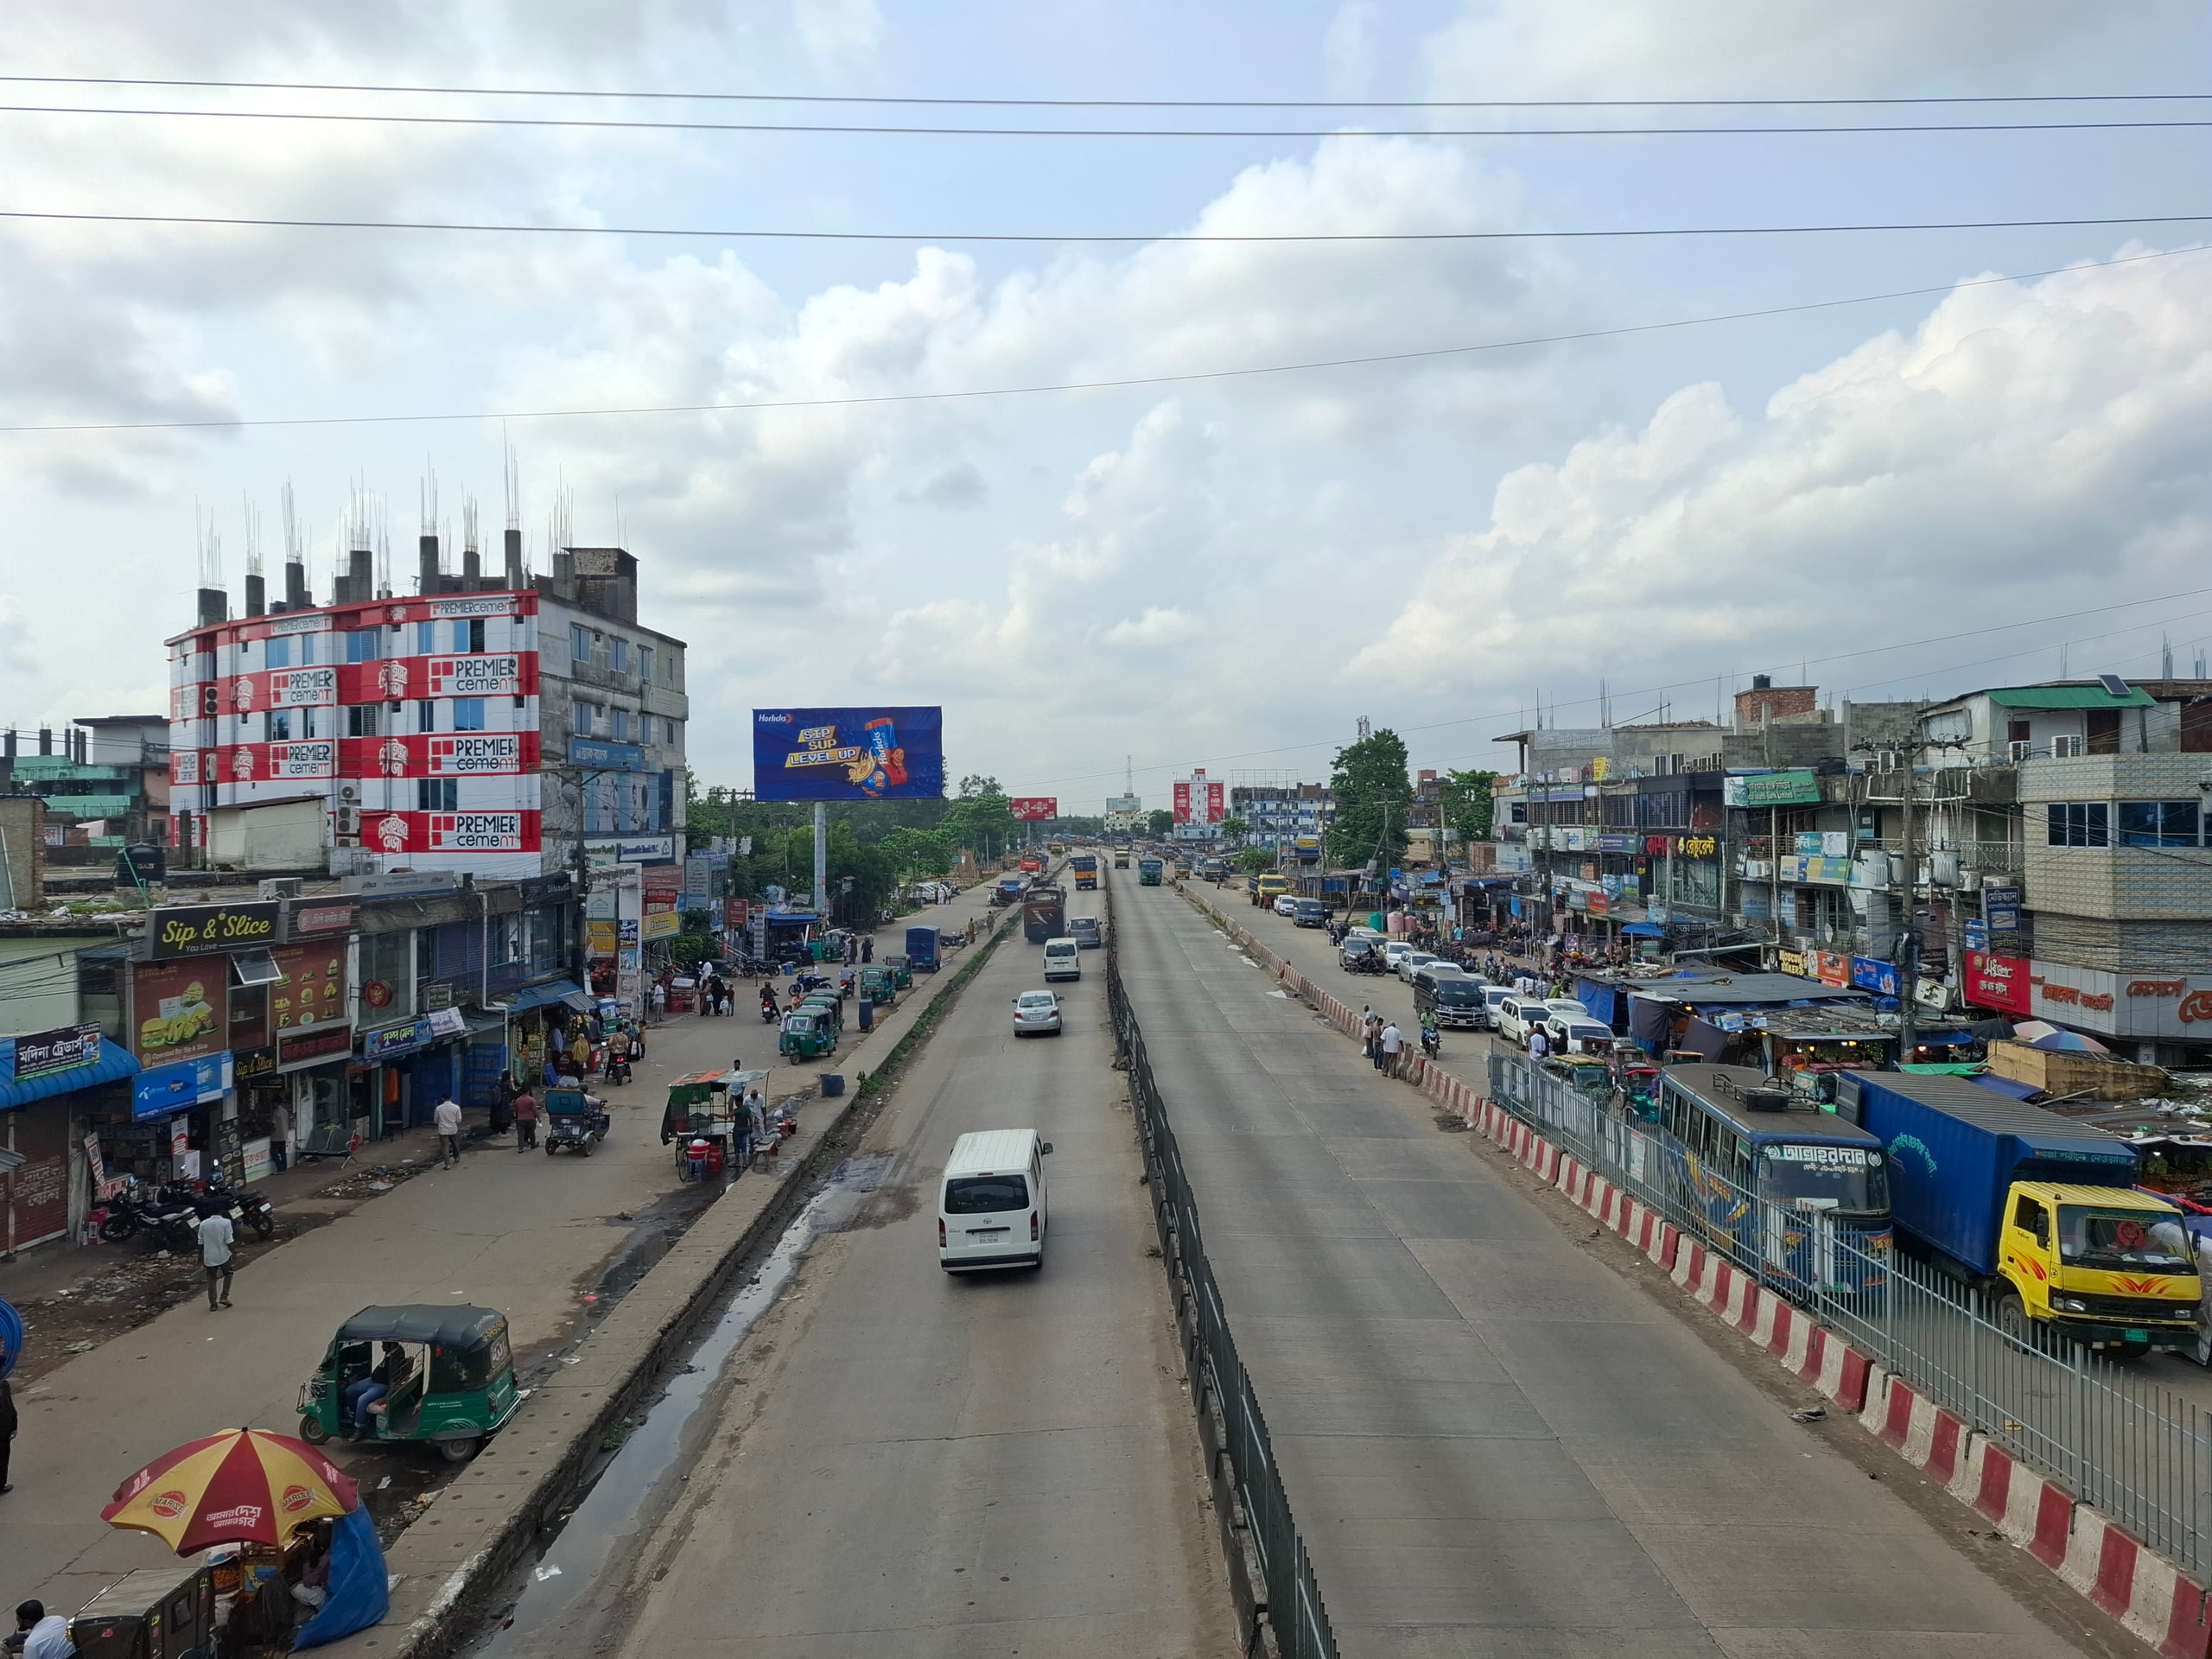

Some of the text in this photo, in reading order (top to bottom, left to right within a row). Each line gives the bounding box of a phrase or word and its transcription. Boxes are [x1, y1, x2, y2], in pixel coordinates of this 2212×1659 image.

[455, 658, 517, 677] PREMIER
[290, 671, 334, 690] PREMIER
[290, 689, 332, 702] cement
[759, 714, 786, 723] Horlicks
[804, 728, 830, 741] SIP
[289, 744, 330, 762] PREMIER
[456, 739, 513, 757] PREMIER
[808, 738, 836, 751] SUP
[457, 758, 514, 771] cement
[790, 748, 856, 766] LEVEL UP
[289, 763, 330, 774] cement
[457, 816, 515, 833] PREMIER
[457, 836, 515, 847] cement
[162, 915, 271, 950] Sip & Slice
[186, 943, 218, 953] You Love
[19, 1034, 84, 1063] মদিনা ট্রেডার্স
[235, 1056, 274, 1079] Sip & Slice
[153, 1497, 185, 1515] MARISE
[283, 1490, 314, 1510] MARISE
[207, 1510, 234, 1522] আমার
[213, 1517, 238, 1528] আমার
